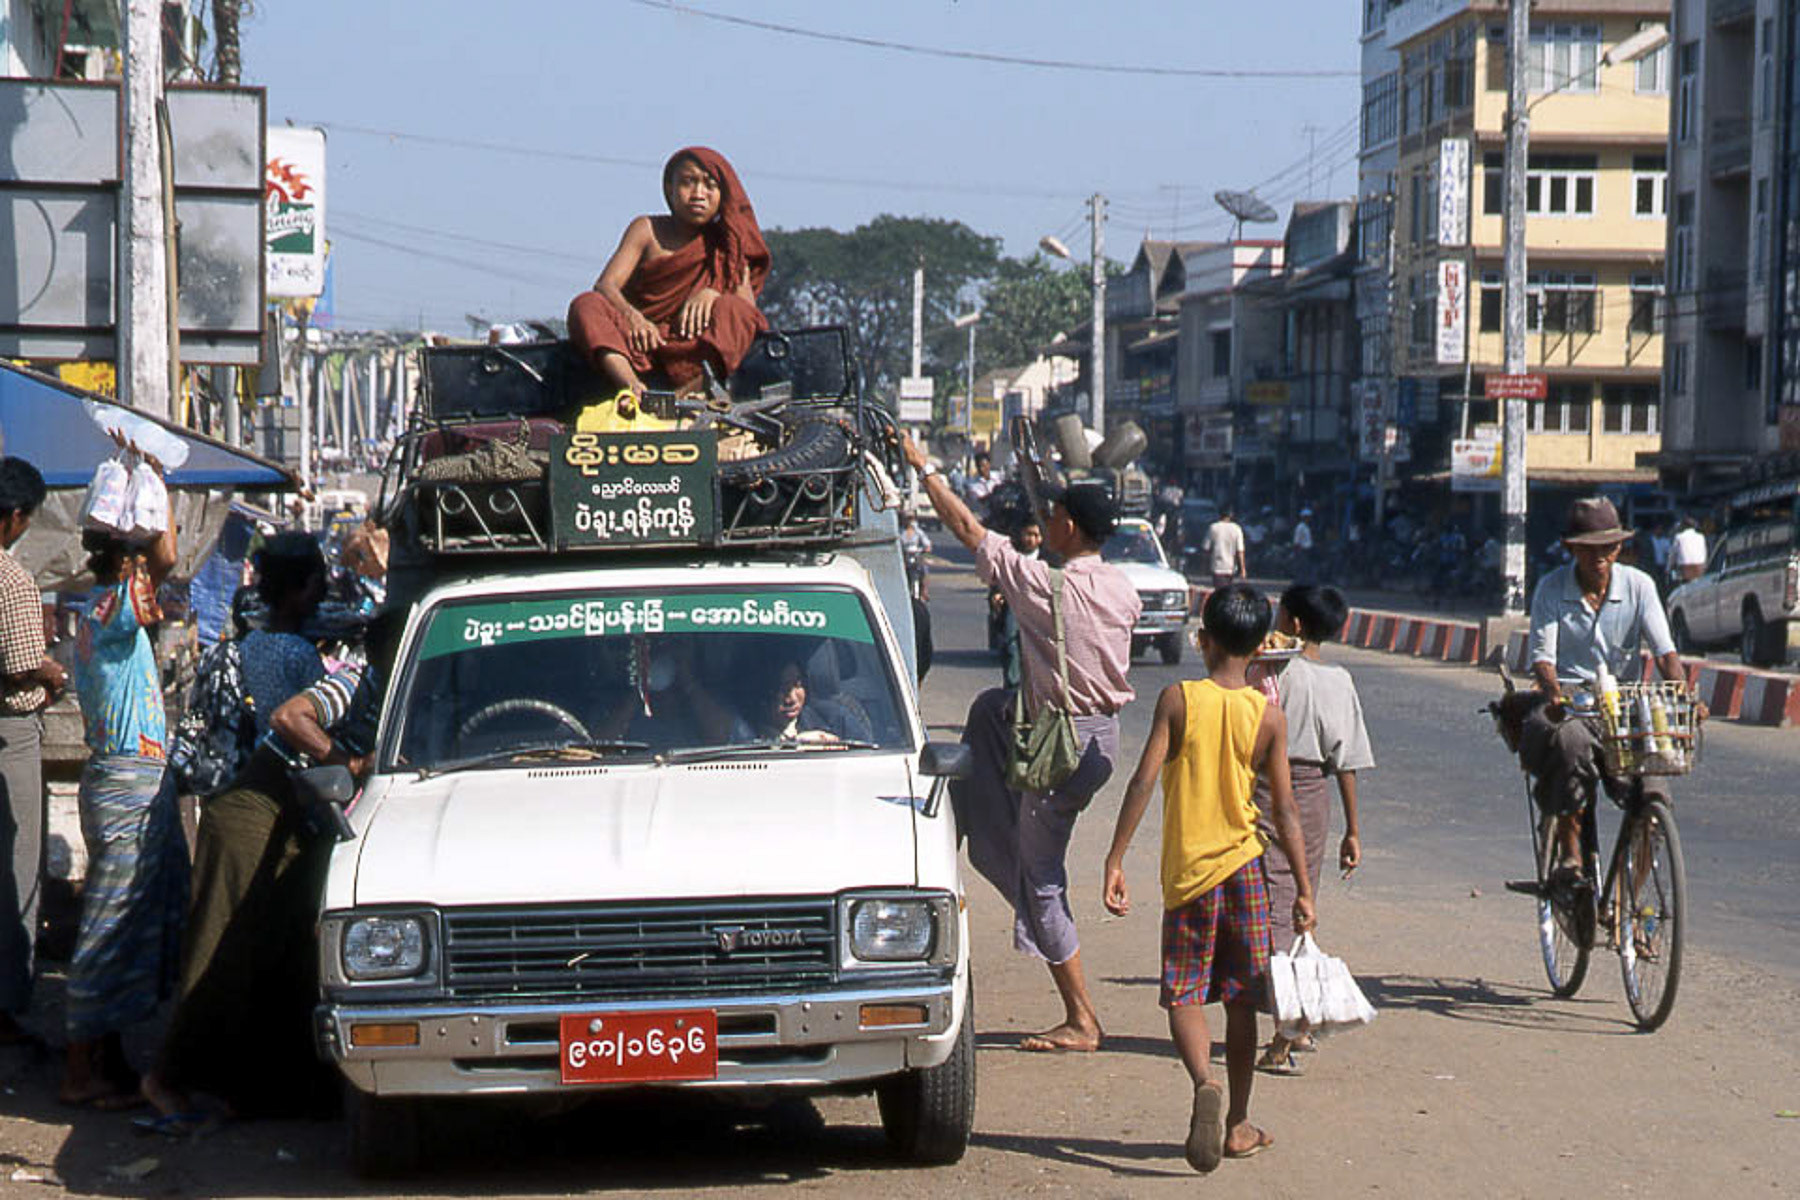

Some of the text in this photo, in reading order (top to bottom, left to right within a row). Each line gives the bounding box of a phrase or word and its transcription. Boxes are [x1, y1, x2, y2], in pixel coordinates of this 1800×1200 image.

[743, 930, 802, 946] TOYOTA
[568, 1026, 707, 1068] ၉က/၁၆၃၆
